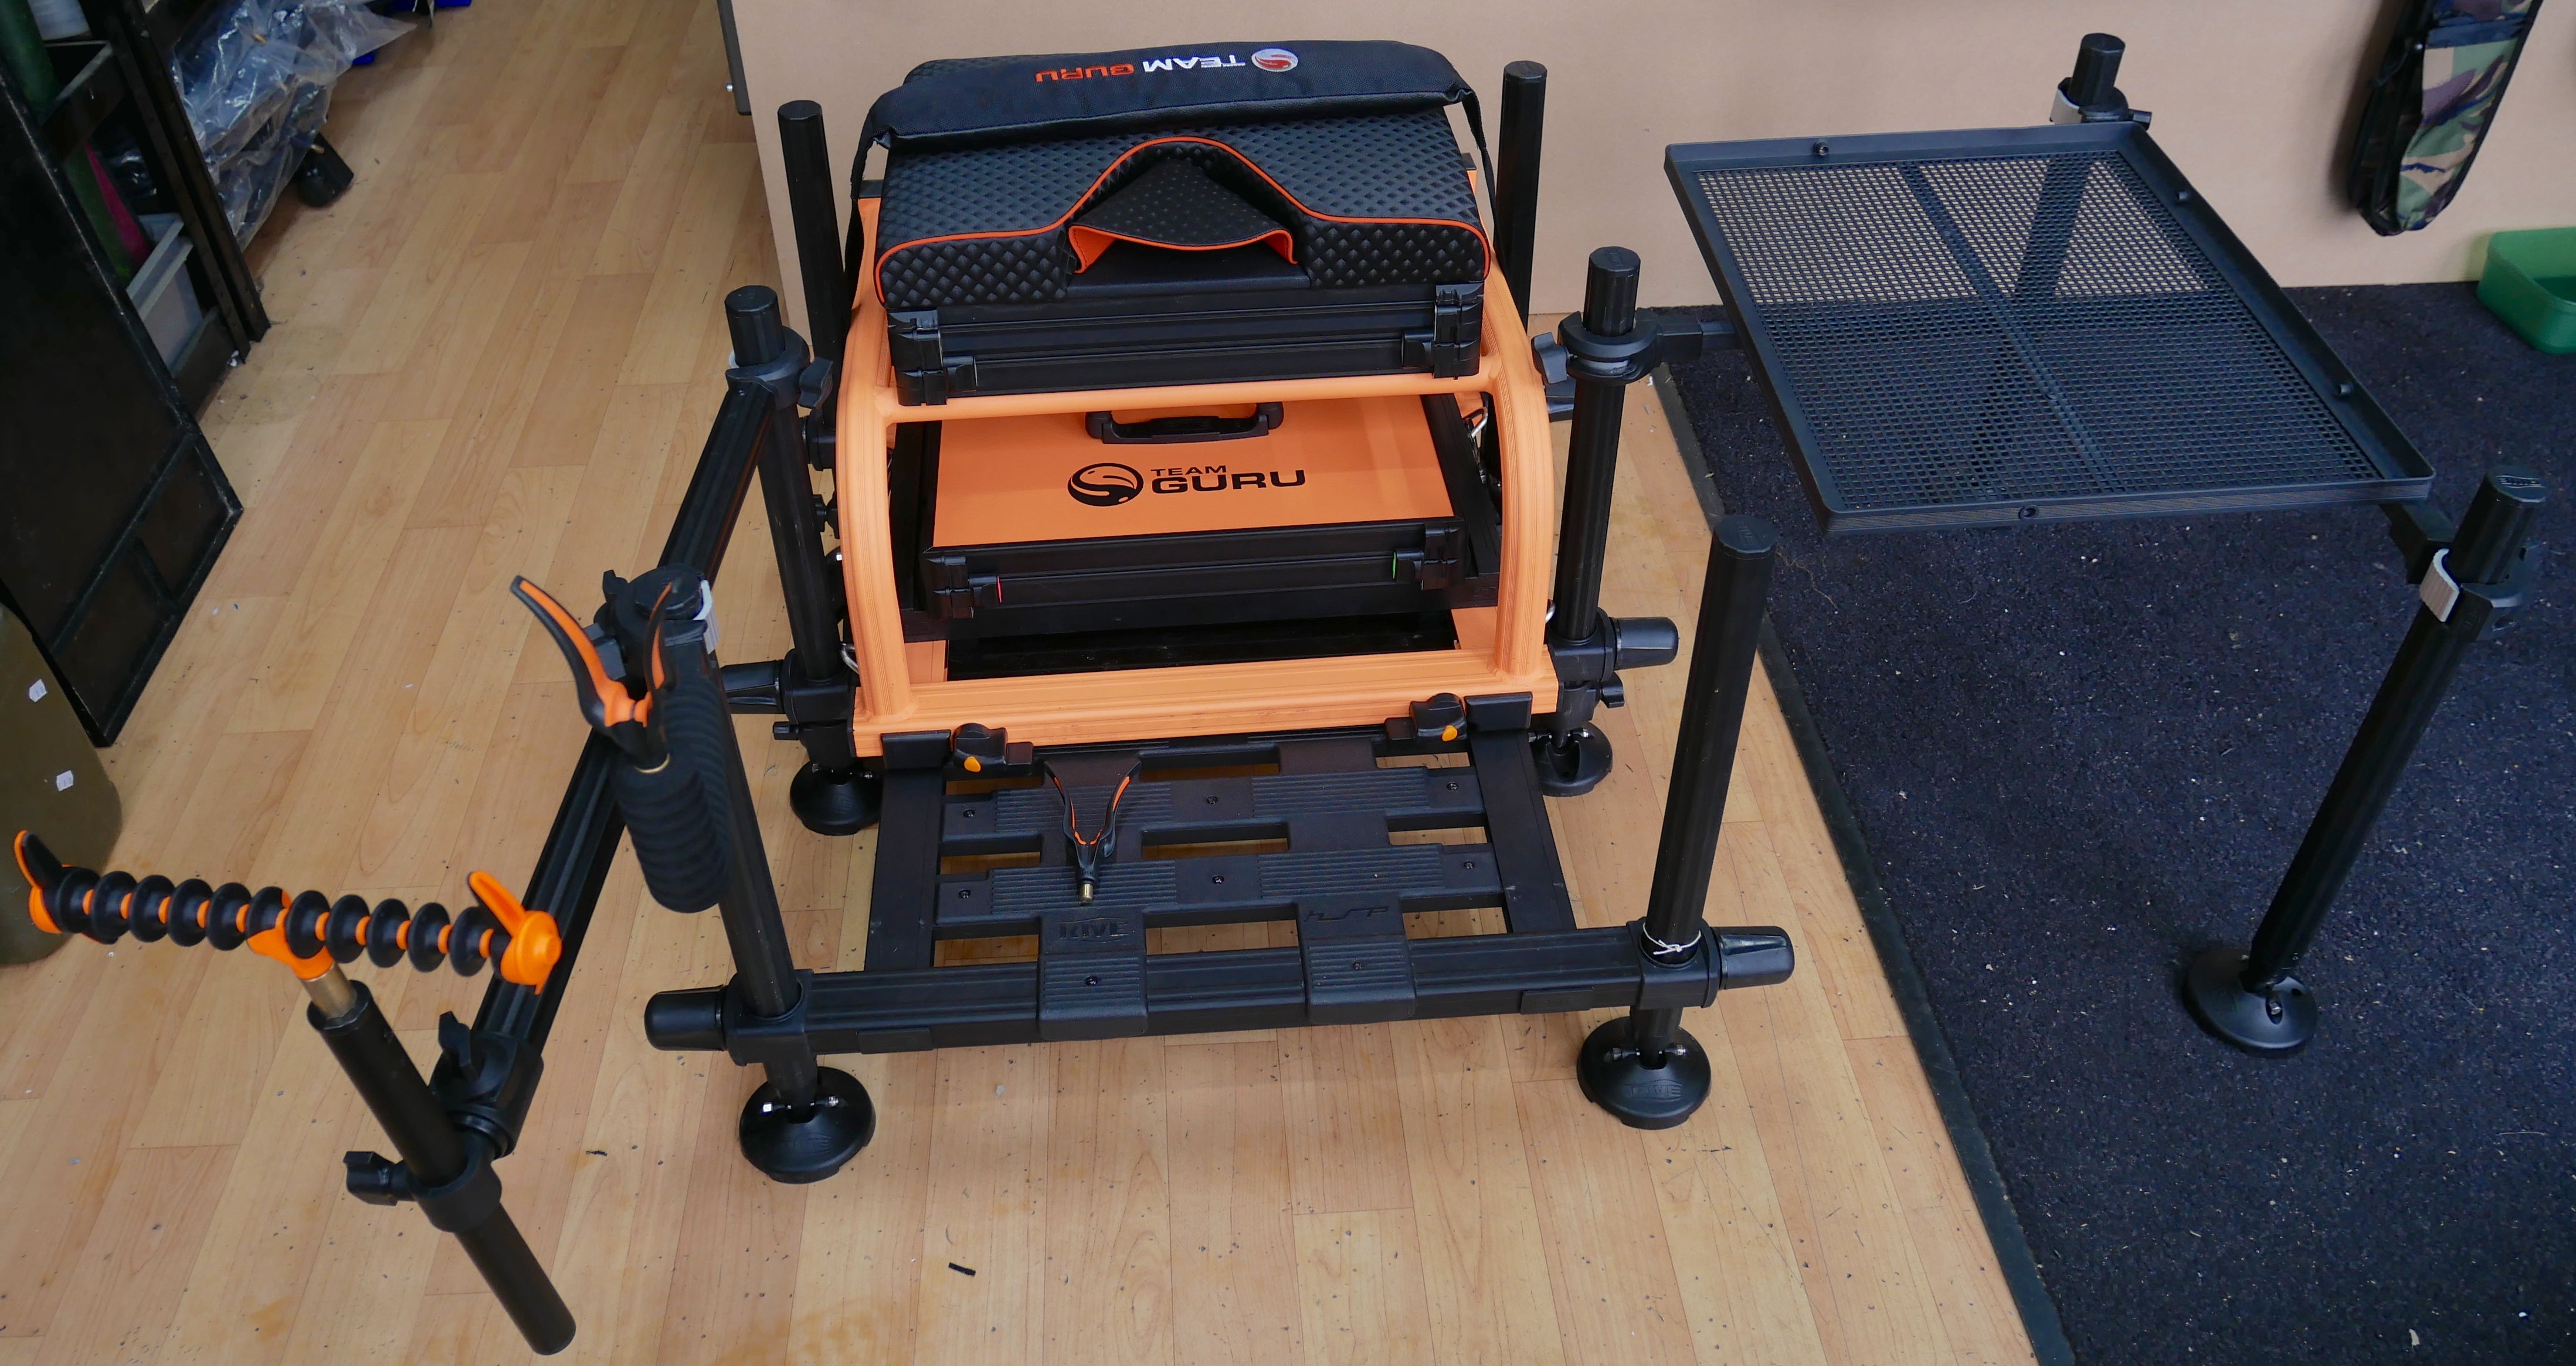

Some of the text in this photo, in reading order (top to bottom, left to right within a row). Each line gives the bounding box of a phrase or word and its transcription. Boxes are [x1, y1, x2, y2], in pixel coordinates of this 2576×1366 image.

[1034, 54, 1246, 83] TEAM GURU
[1150, 465, 1227, 477] TEAM
[1151, 470, 1306, 494] GURU
[1058, 922, 1129, 939] RIVE
